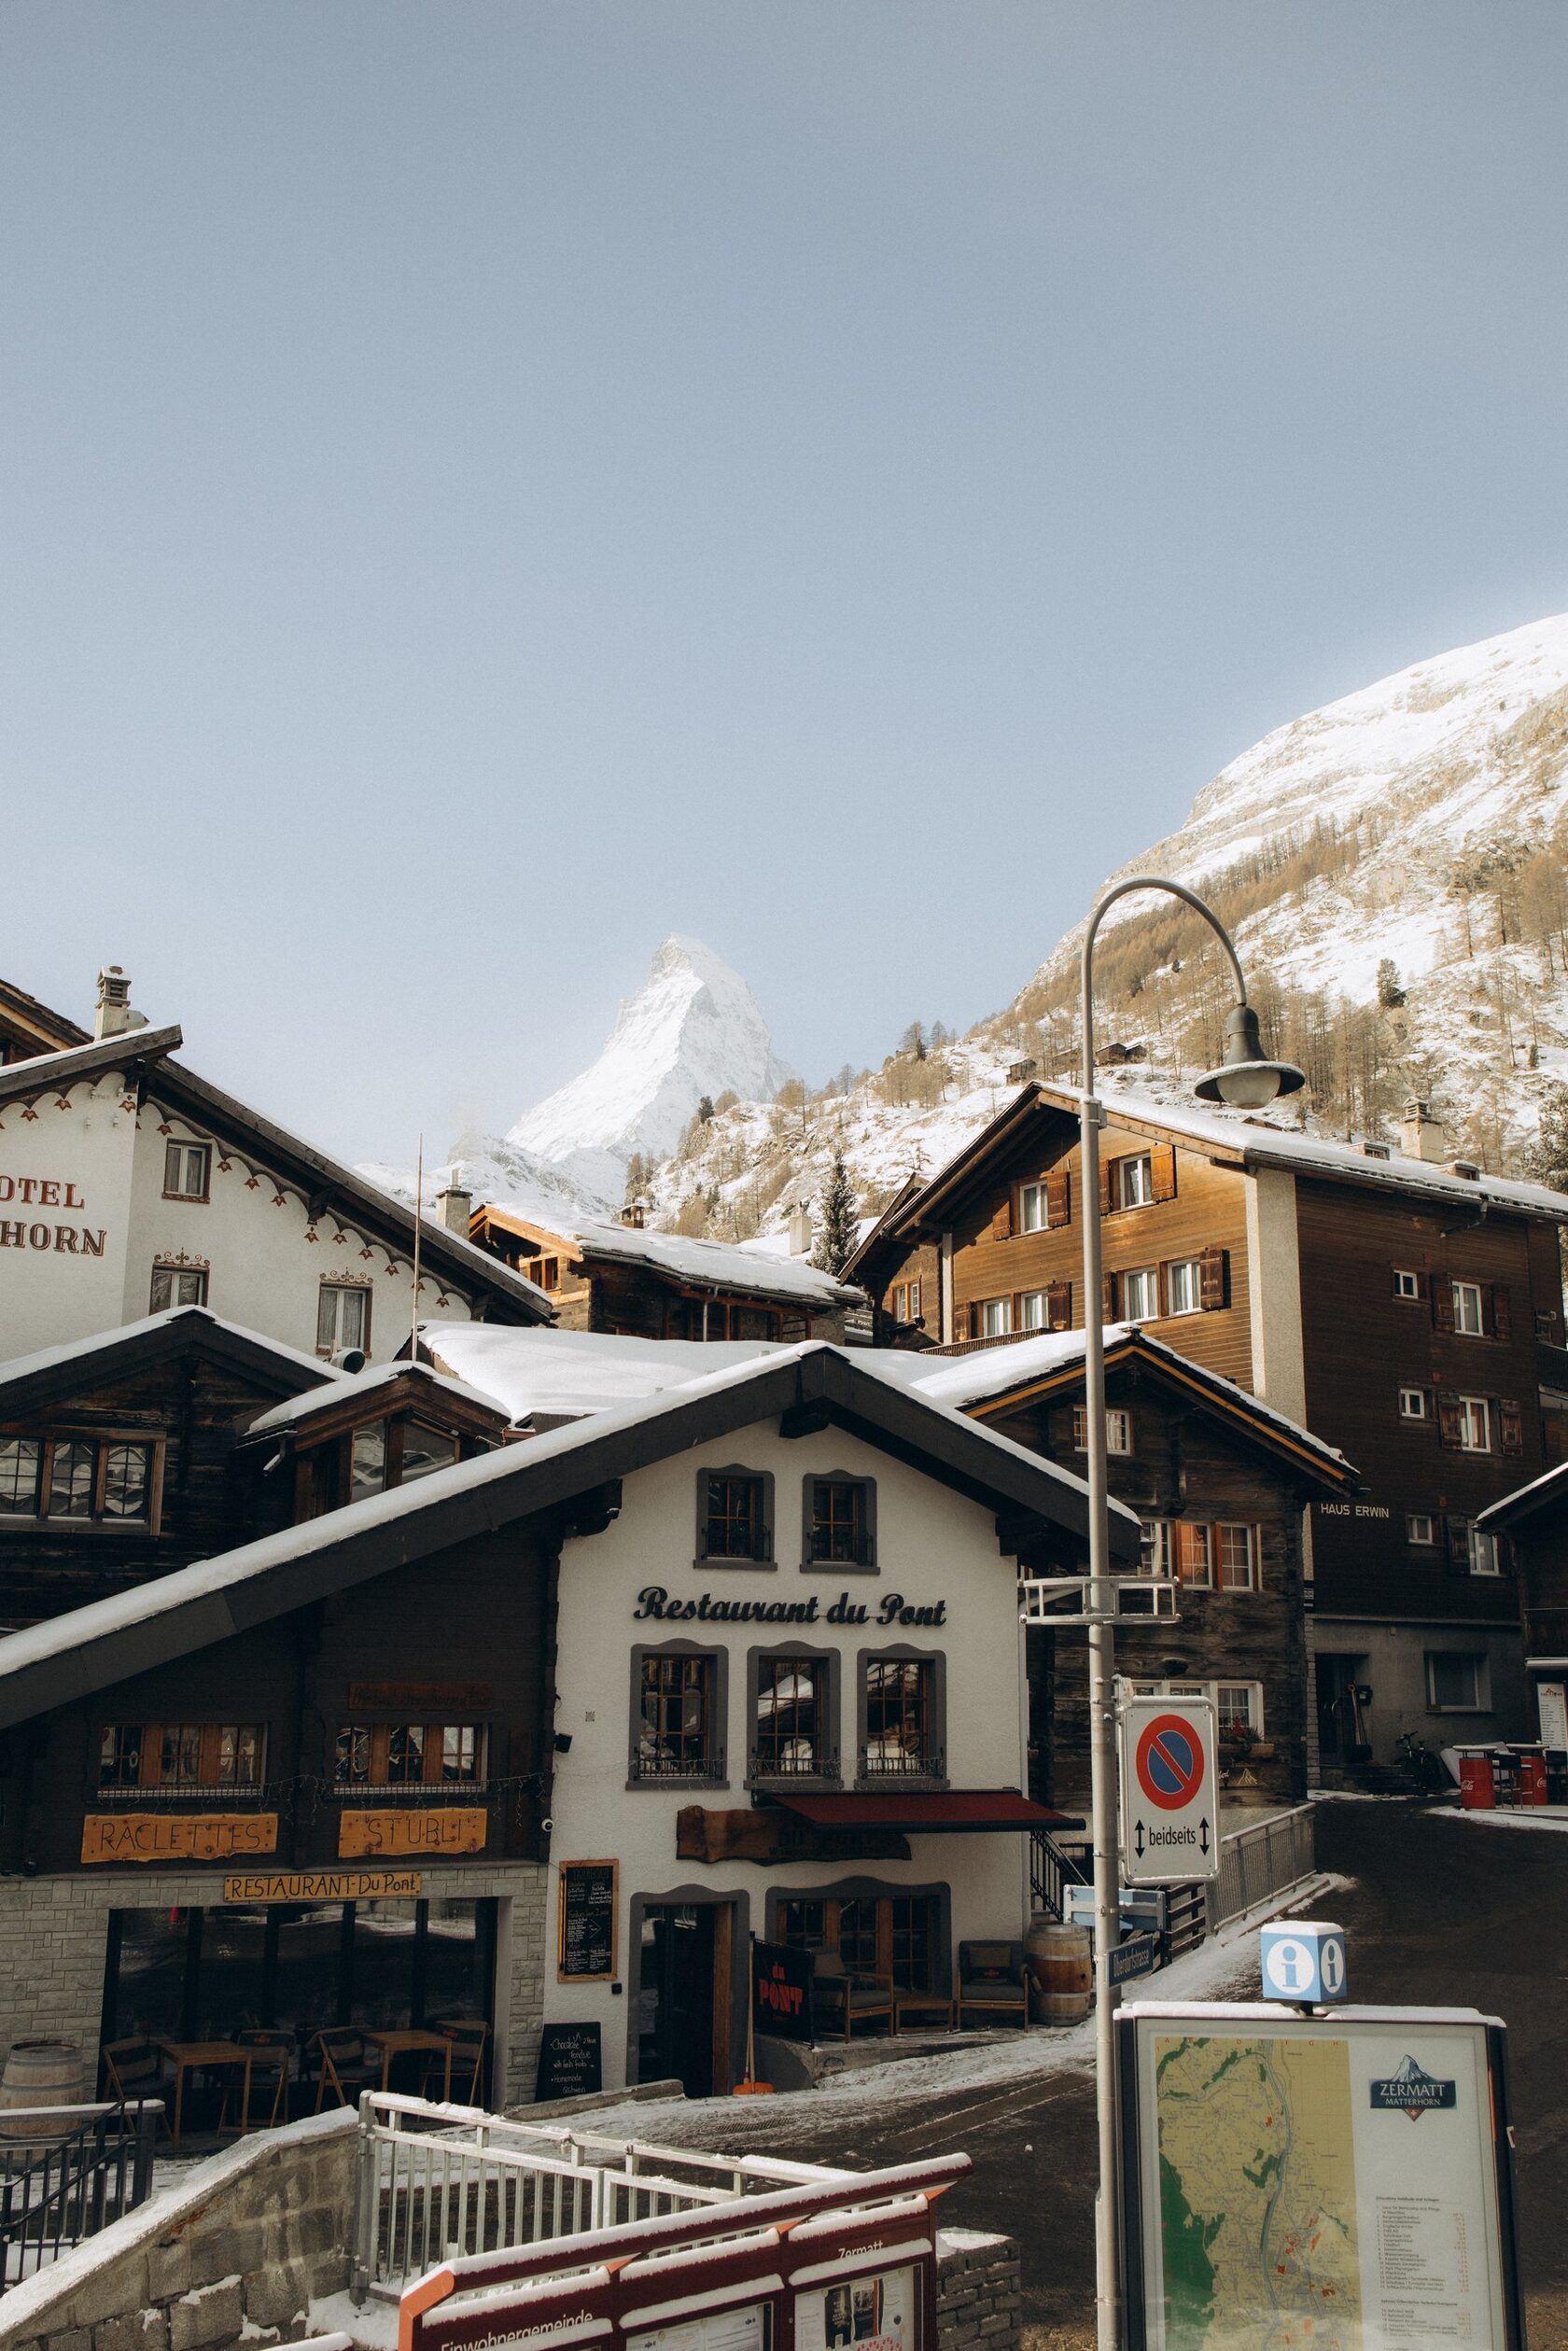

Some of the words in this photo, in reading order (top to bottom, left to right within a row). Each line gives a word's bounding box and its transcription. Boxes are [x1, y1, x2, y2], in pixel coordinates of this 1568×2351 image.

[0, 1175, 85, 1210] OTEL
[0, 1220, 107, 1257] HORN
[1321, 1503, 1351, 1516] HAUS
[1355, 1504, 1390, 1518] ERWIN
[634, 1586, 819, 1624] Restaurant
[826, 1591, 869, 1624] du
[875, 1593, 946, 1626] Pont
[100, 1822, 261, 1853] RACLETTES
[1148, 1826, 1197, 1847] beidseits
[383, 1871, 416, 1895] Pont
[771, 1961, 786, 1980] du
[758, 1977, 805, 2016] PONT
[1379, 2082, 1446, 2097] ZERMATT
[1385, 2098, 1442, 2106] MATTERHORN
